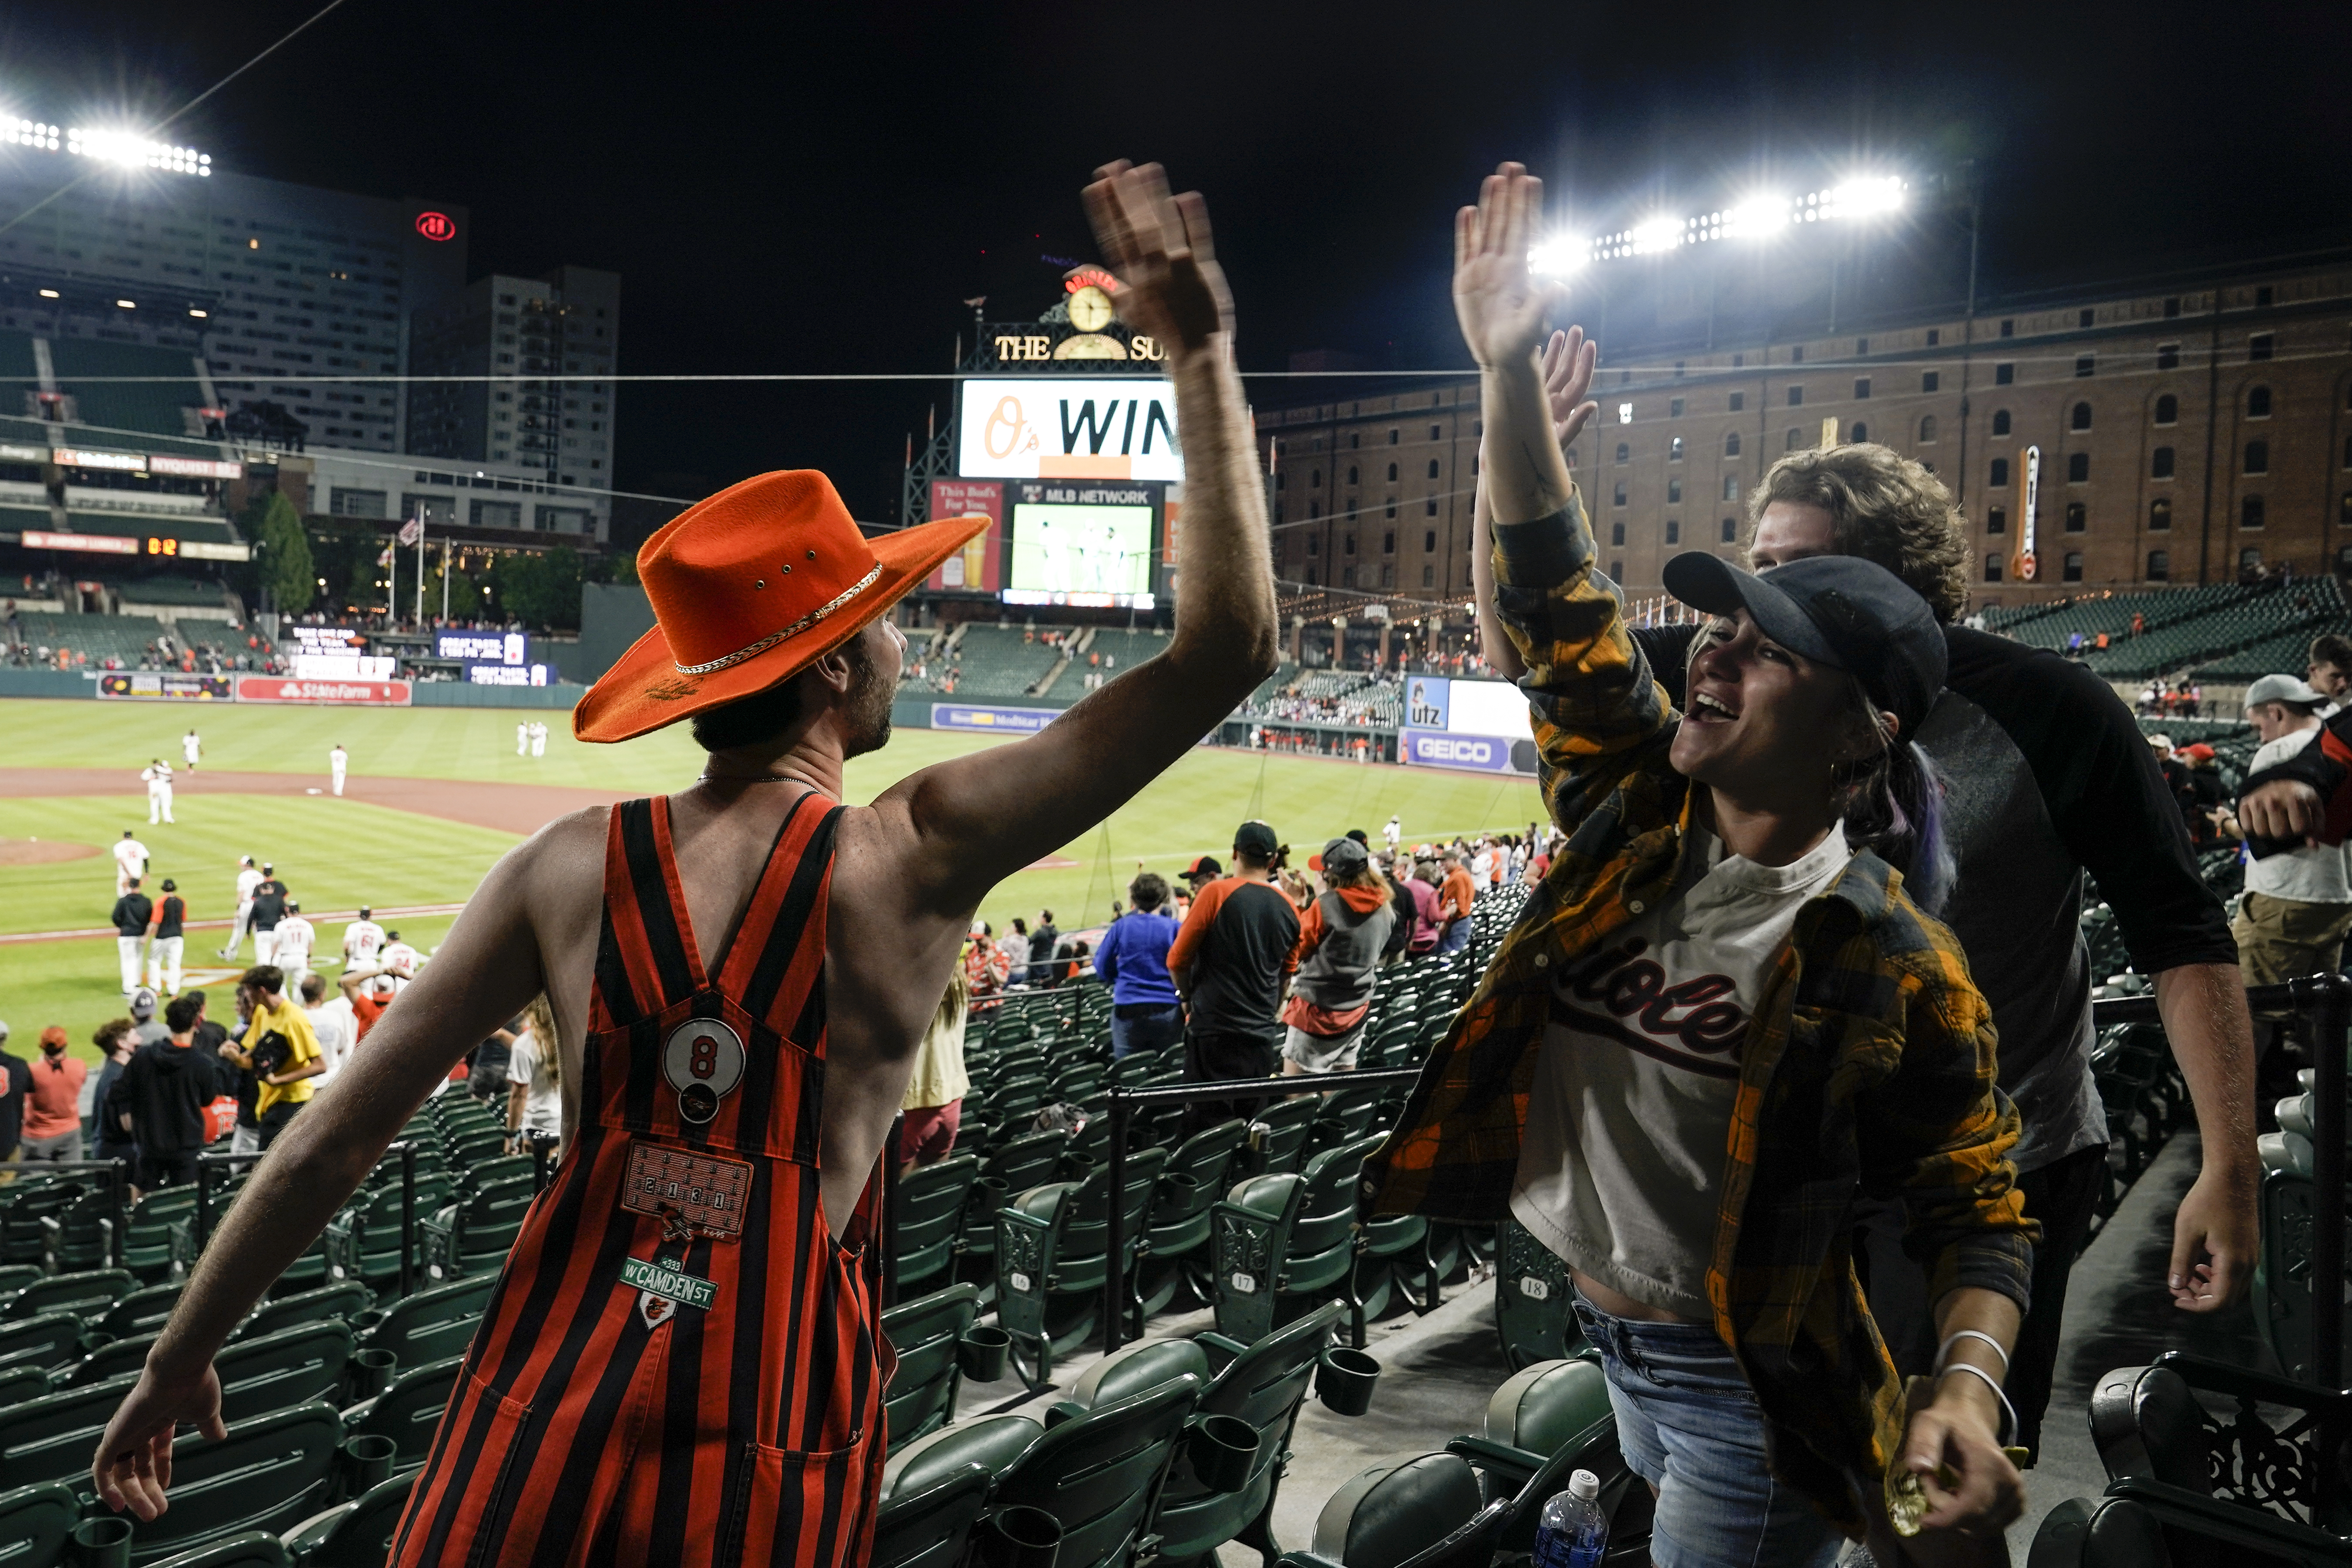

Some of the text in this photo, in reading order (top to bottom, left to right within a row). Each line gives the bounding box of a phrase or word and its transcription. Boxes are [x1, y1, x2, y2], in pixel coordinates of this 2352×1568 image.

[995, 335, 1170, 361] THE SU
[938, 485, 996, 498] This Bud's
[1046, 489, 1076, 503] MLB
[1079, 489, 1148, 504] NETWORK
[945, 498, 963, 510] For
[1413, 704, 1440, 725] utz
[1417, 738, 1492, 764] GEICO
[291, 932, 301, 943] 11
[690, 1035, 718, 1080] 8
[625, 1264, 712, 1302] W CAMDEN ST
[1238, 1276, 1251, 1289] 17
[1527, 1280, 1542, 1296] 18
